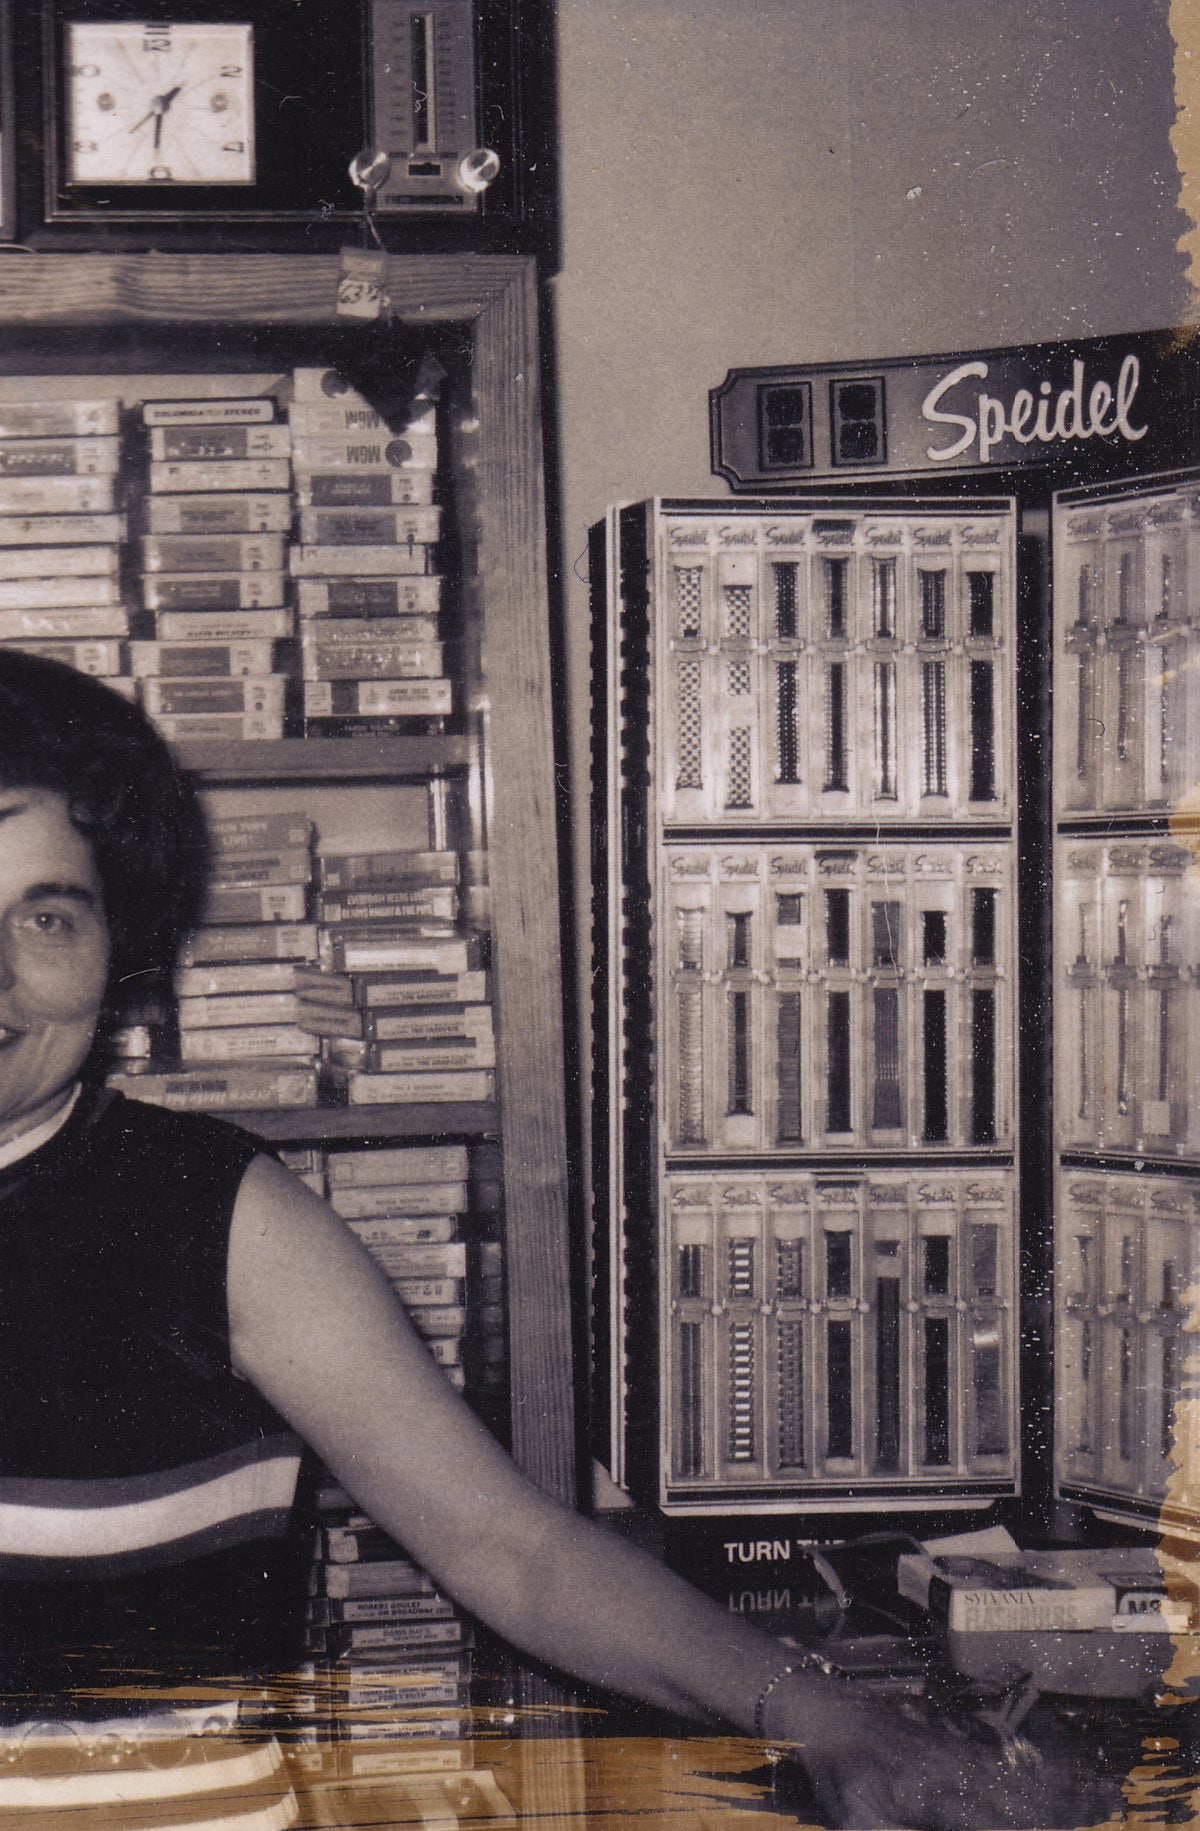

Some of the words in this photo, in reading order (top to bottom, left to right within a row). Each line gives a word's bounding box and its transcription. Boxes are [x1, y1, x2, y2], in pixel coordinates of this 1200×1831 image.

[220, 65, 243, 78] 2
[922, 354, 1148, 463] Speidel
[346, 445, 381, 464] MGM
[724, 1540, 791, 1563] TURN
[390, 1601, 420, 1609] GOULET
[964, 1593, 1034, 1605] SYLVANIA
[391, 1608, 434, 1616] BROADWAY
